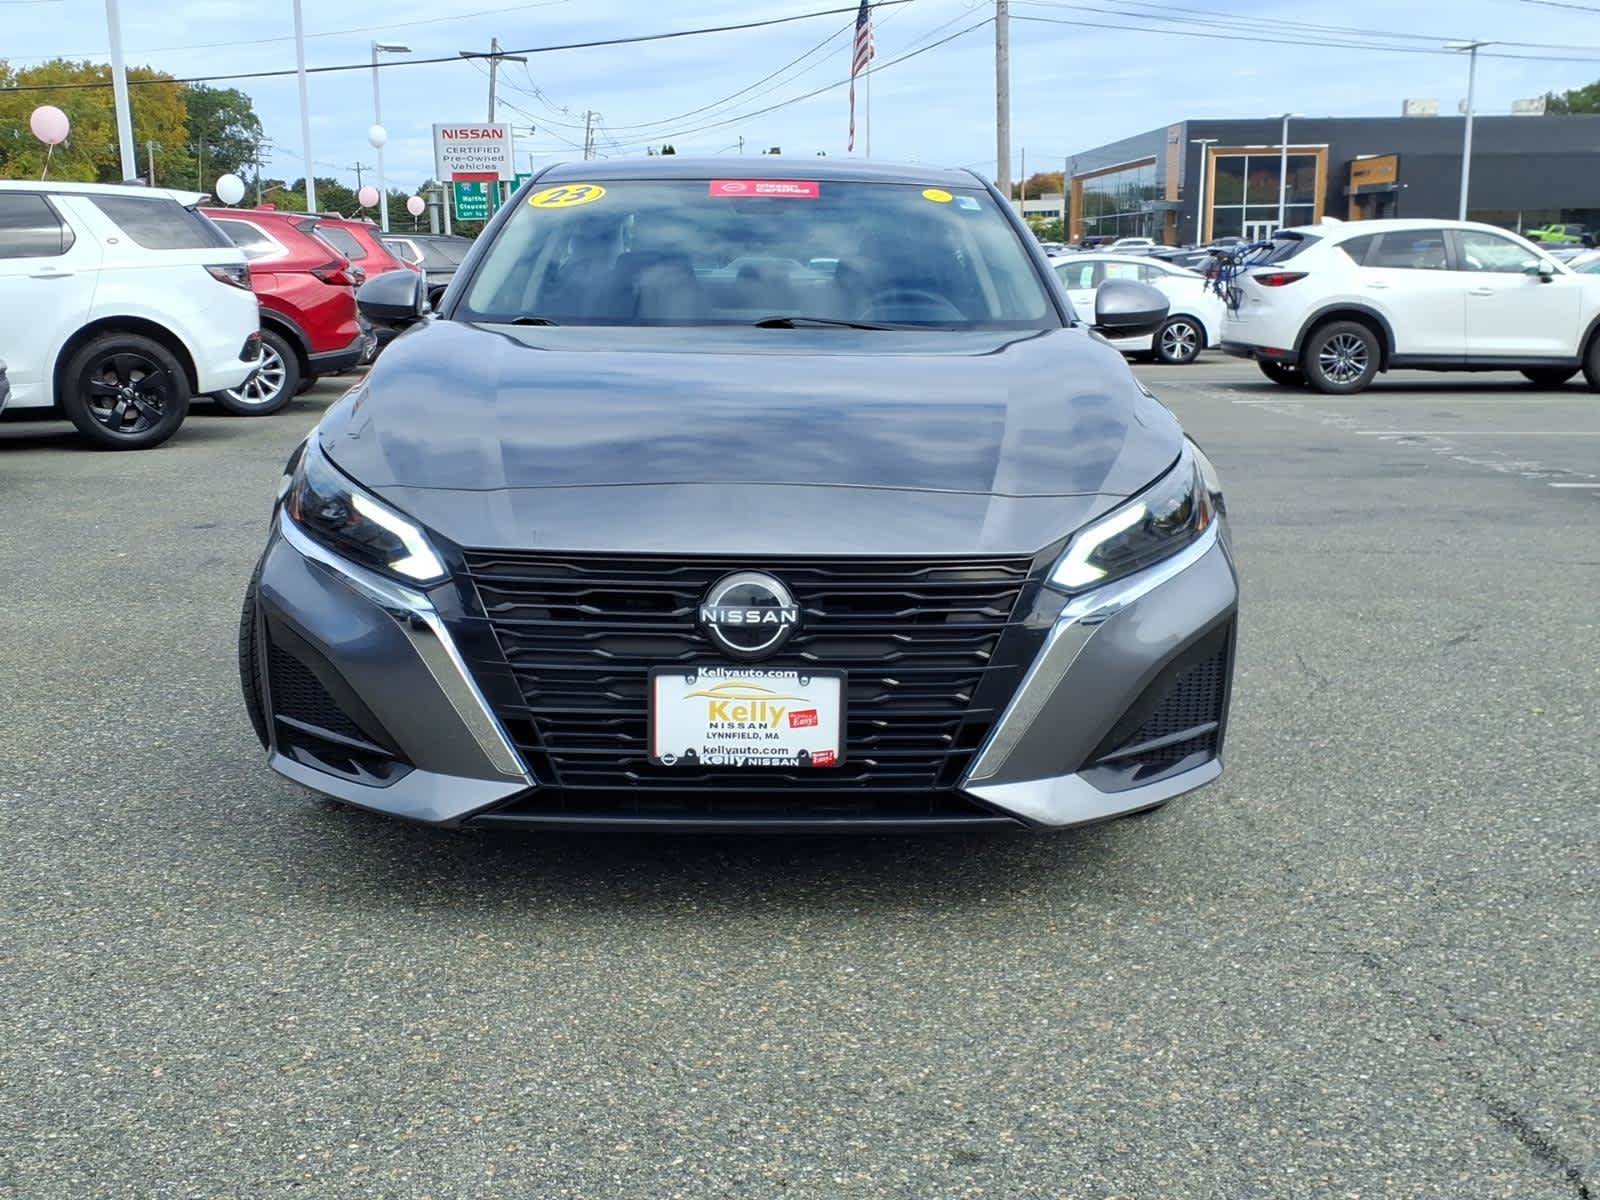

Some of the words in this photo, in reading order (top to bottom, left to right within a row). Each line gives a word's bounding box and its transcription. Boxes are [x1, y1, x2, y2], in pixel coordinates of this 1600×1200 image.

[442, 129, 503, 139] NISSAN
[446, 146, 500, 154] CERTIFIED
[702, 609, 797, 623] NISSAN
[698, 667, 798, 679] Kellyauto.com
[709, 700, 785, 729] Kelly
[706, 732, 762, 740] LYNNFIELD,
[699, 755, 746, 767] Kelly
[748, 758, 800, 766] NISSAN
